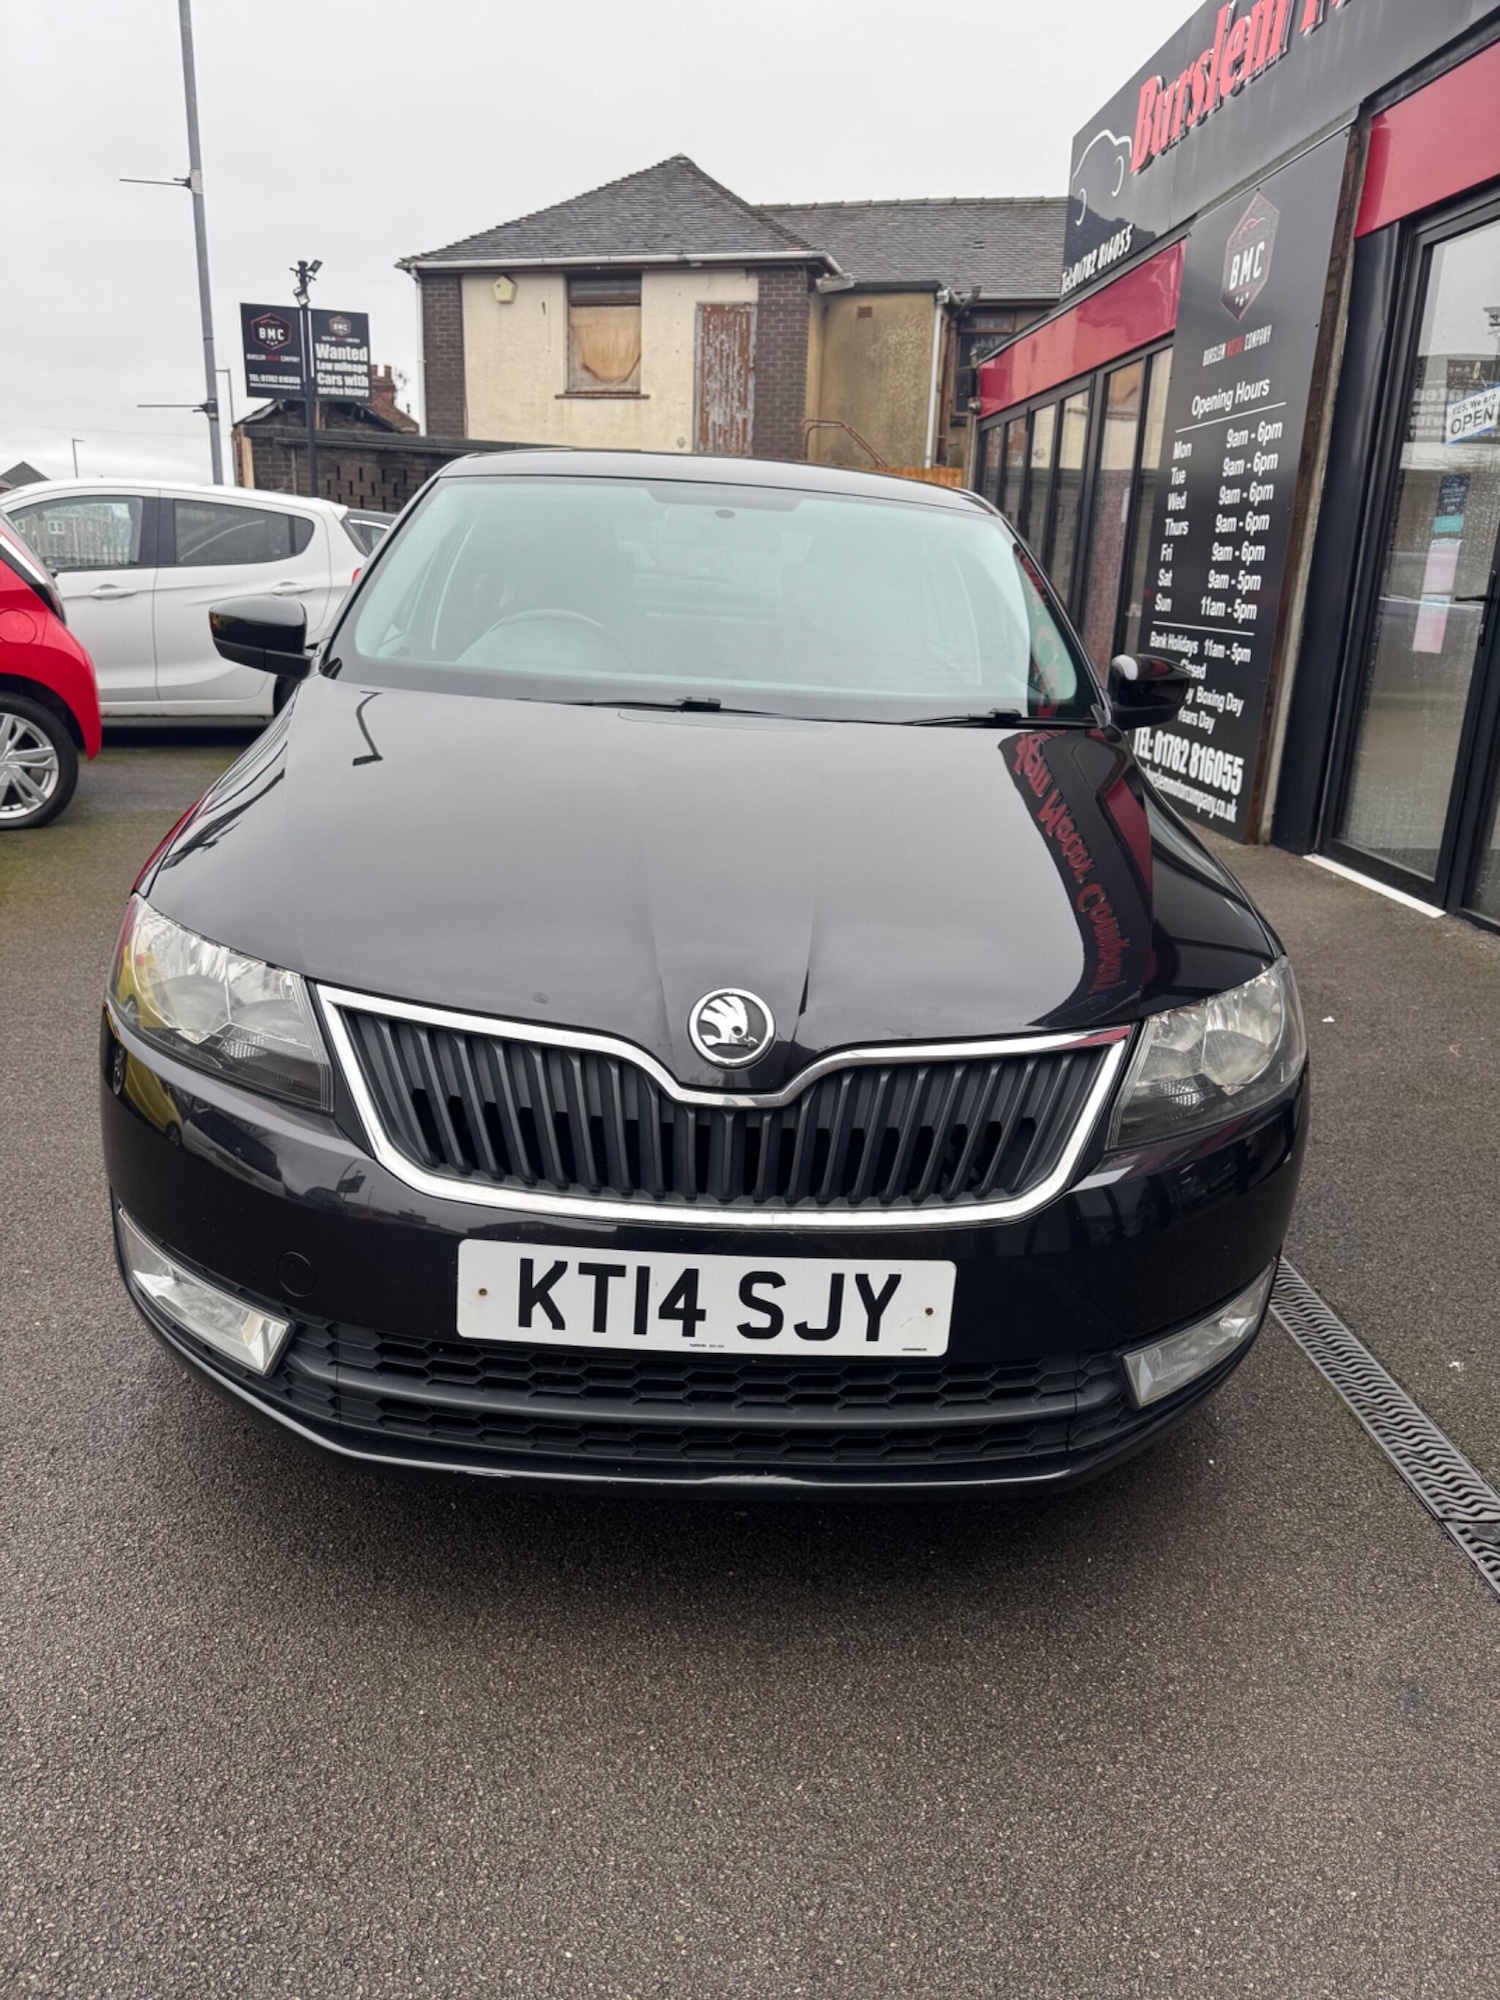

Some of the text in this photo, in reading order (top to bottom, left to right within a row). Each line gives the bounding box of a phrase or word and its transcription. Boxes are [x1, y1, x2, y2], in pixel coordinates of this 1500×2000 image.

[1130, 0, 1291, 176] Burslem
[1229, 241, 1265, 291] BMC
[259, 327, 284, 340] BMC
[315, 342, 368, 361] Wanted
[316, 360, 368, 373] Low mileage
[317, 372, 369, 387] Cars with
[317, 386, 369, 398] service history
[1191, 379, 1270, 419] Opening Hours
[1451, 404, 1495, 435] OPEN
[1173, 441, 1192, 460] Mon
[1226, 428, 1249, 449] 9am
[1257, 420, 1283, 447] 6pm
[1171, 467, 1186, 485] Tue
[1222, 457, 1245, 477] 9am
[1253, 451, 1279, 477] 6pm
[1167, 491, 1187, 511] Wed
[1218, 485, 1241, 506] 9am
[1249, 481, 1274, 507] 6pm
[1165, 518, 1189, 536] Thurs
[1215, 514, 1237, 534] 9am
[1245, 511, 1270, 536] 6pm
[1160, 543, 1174, 562] Fri
[1211, 542, 1233, 562] 9am
[1241, 540, 1266, 566] 6pm
[1158, 568, 1173, 587] Sat
[1207, 569, 1230, 590] 9am
[1236, 570, 1262, 595] 5pm
[1154, 592, 1172, 612] Sun
[1200, 596, 1226, 617] 11am
[1233, 599, 1258, 624] 5pm
[1149, 631, 1167, 649] Bank
[1167, 633, 1199, 658] Holidays
[1204, 638, 1226, 659] 11am
[1231, 642, 1251, 666] 5pm
[1196, 685, 1225, 713] Boxing
[1225, 692, 1244, 718] Day
[1198, 710, 1216, 735] Day
[1133, 726, 1244, 796] TEL: 01782 816055
[517, 1257, 902, 1343] KT14 SJY
